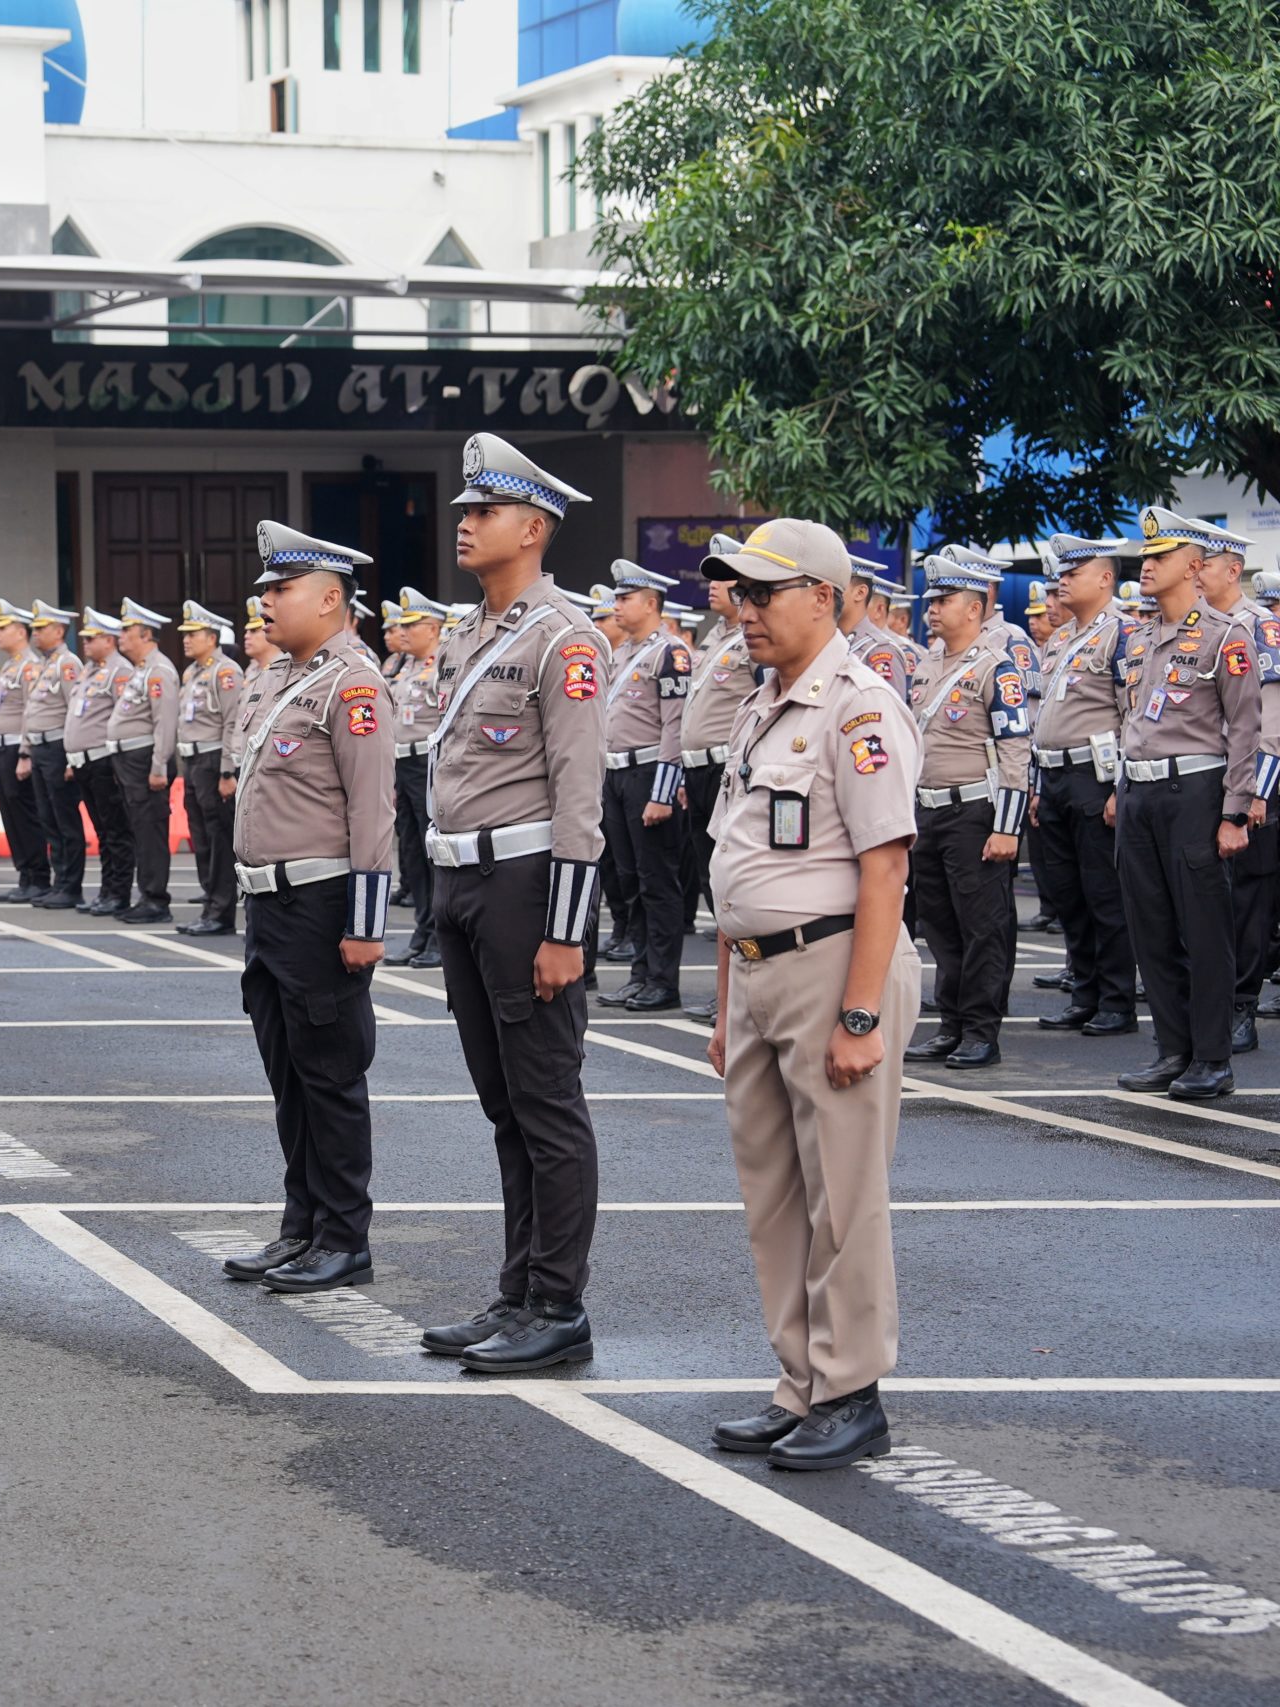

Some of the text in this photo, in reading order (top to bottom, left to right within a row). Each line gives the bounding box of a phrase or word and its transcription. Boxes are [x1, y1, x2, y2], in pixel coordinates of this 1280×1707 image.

[17, 360, 312, 413] MASJID
[1170, 655, 1199, 666] POLRI
[484, 664, 523, 682] POLRI
[343, 688, 375, 698] KORLANTAS
[289, 695, 319, 710] OLRI
[843, 713, 881, 733] KORLANTAS
